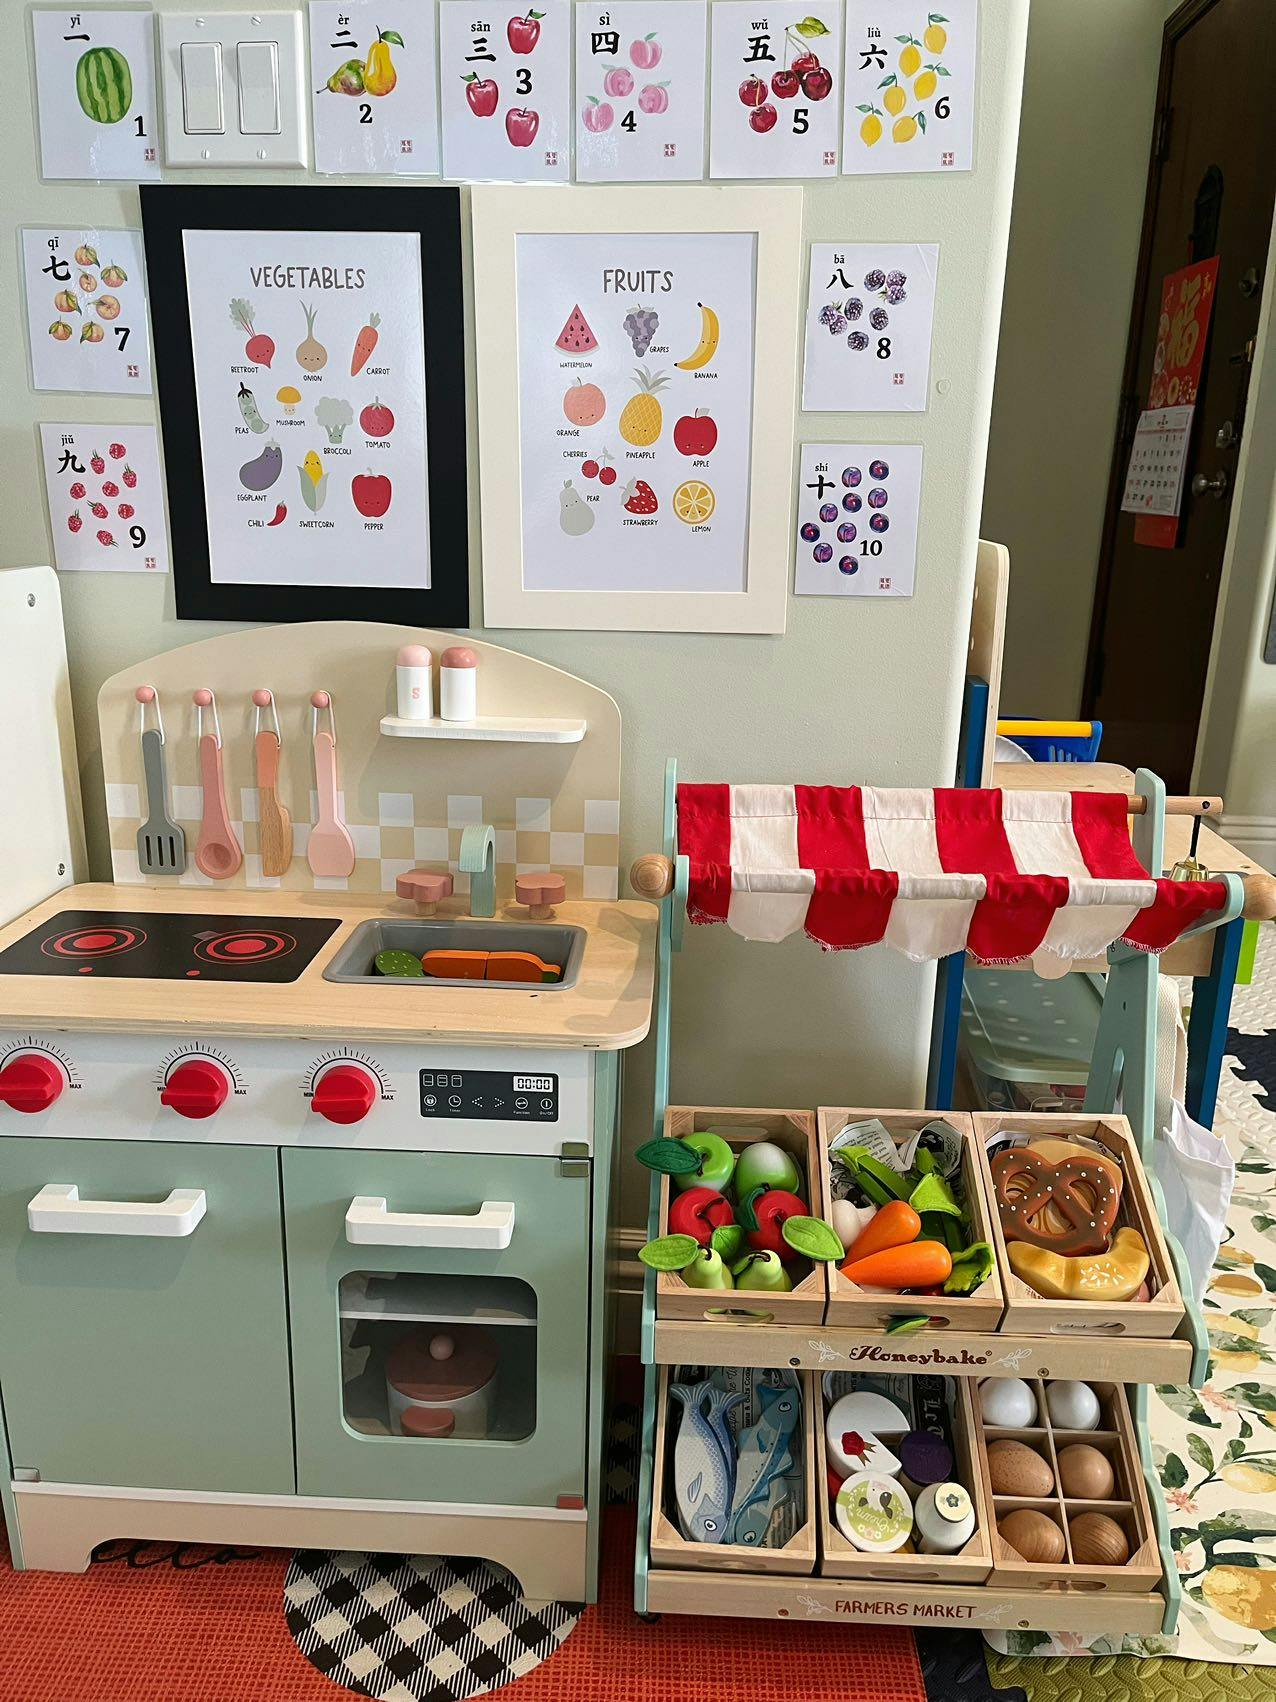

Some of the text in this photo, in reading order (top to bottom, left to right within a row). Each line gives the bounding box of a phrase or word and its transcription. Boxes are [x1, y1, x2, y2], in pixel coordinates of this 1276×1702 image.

[71, 14, 80, 28] yī
[337, 13, 350, 25] èr
[600, 12, 610, 25] sì
[750, 18, 769, 31] wǔ
[470, 20, 491, 33] sān
[867, 27, 881, 38] liù
[63, 33, 91, 42] 一
[331, 30, 358, 48] 二
[591, 31, 620, 55] 四
[465, 38, 496, 62] 三
[743, 35, 775, 62] 五
[859, 44, 887, 70] 六
[516, 69, 532, 94] 3
[360, 104, 372, 123] 2
[934, 96, 951, 120] 6
[135, 116, 147, 136] 1
[621, 111, 636, 132] 4
[793, 109, 809, 134] 5
[48, 237, 59, 250] qī
[833, 253, 845, 265] bā
[42, 256, 71, 281] 七
[250, 265, 365, 289] VEGETABLES
[604, 269, 673, 293] FRUITS
[826, 269, 854, 289] 八
[115, 327, 130, 351] 7
[649, 345, 669, 353] GRAPES
[877, 338, 891, 359] 8
[230, 366, 258, 374] BEETROOT
[366, 366, 391, 375] CARROT
[559, 361, 593, 369] WATERMELON
[303, 374, 323, 382] ONION
[275, 419, 306, 427] MUSHROOM
[234, 426, 249, 435] PEAS
[556, 429, 580, 437] ORANGE
[61, 434, 75, 447] jiǔ
[365, 440, 391, 449] TOMATO
[323, 447, 352, 456] BROCCOLI
[562, 450, 588, 458] CHERRIES
[625, 451, 656, 460] PINEAPPLE
[57, 450, 86, 473] 九
[692, 459, 710, 468] APPLE
[814, 462, 829, 472] shí
[806, 475, 835, 500] 十
[237, 493, 267, 502] EGGPLANT
[247, 519, 265, 528] CHILI
[298, 520, 335, 529] SWEETCORN
[364, 522, 384, 531] PEPPER
[622, 518, 659, 527] STRAWBERRY
[691, 524, 711, 533] LEMON
[130, 526, 146, 548] 9
[860, 540, 882, 556] 10
[412, 687, 420, 699] S
[517, 1078, 550, 1090] 00:00
[836, 1601, 976, 1618] FARMERS MARKET
